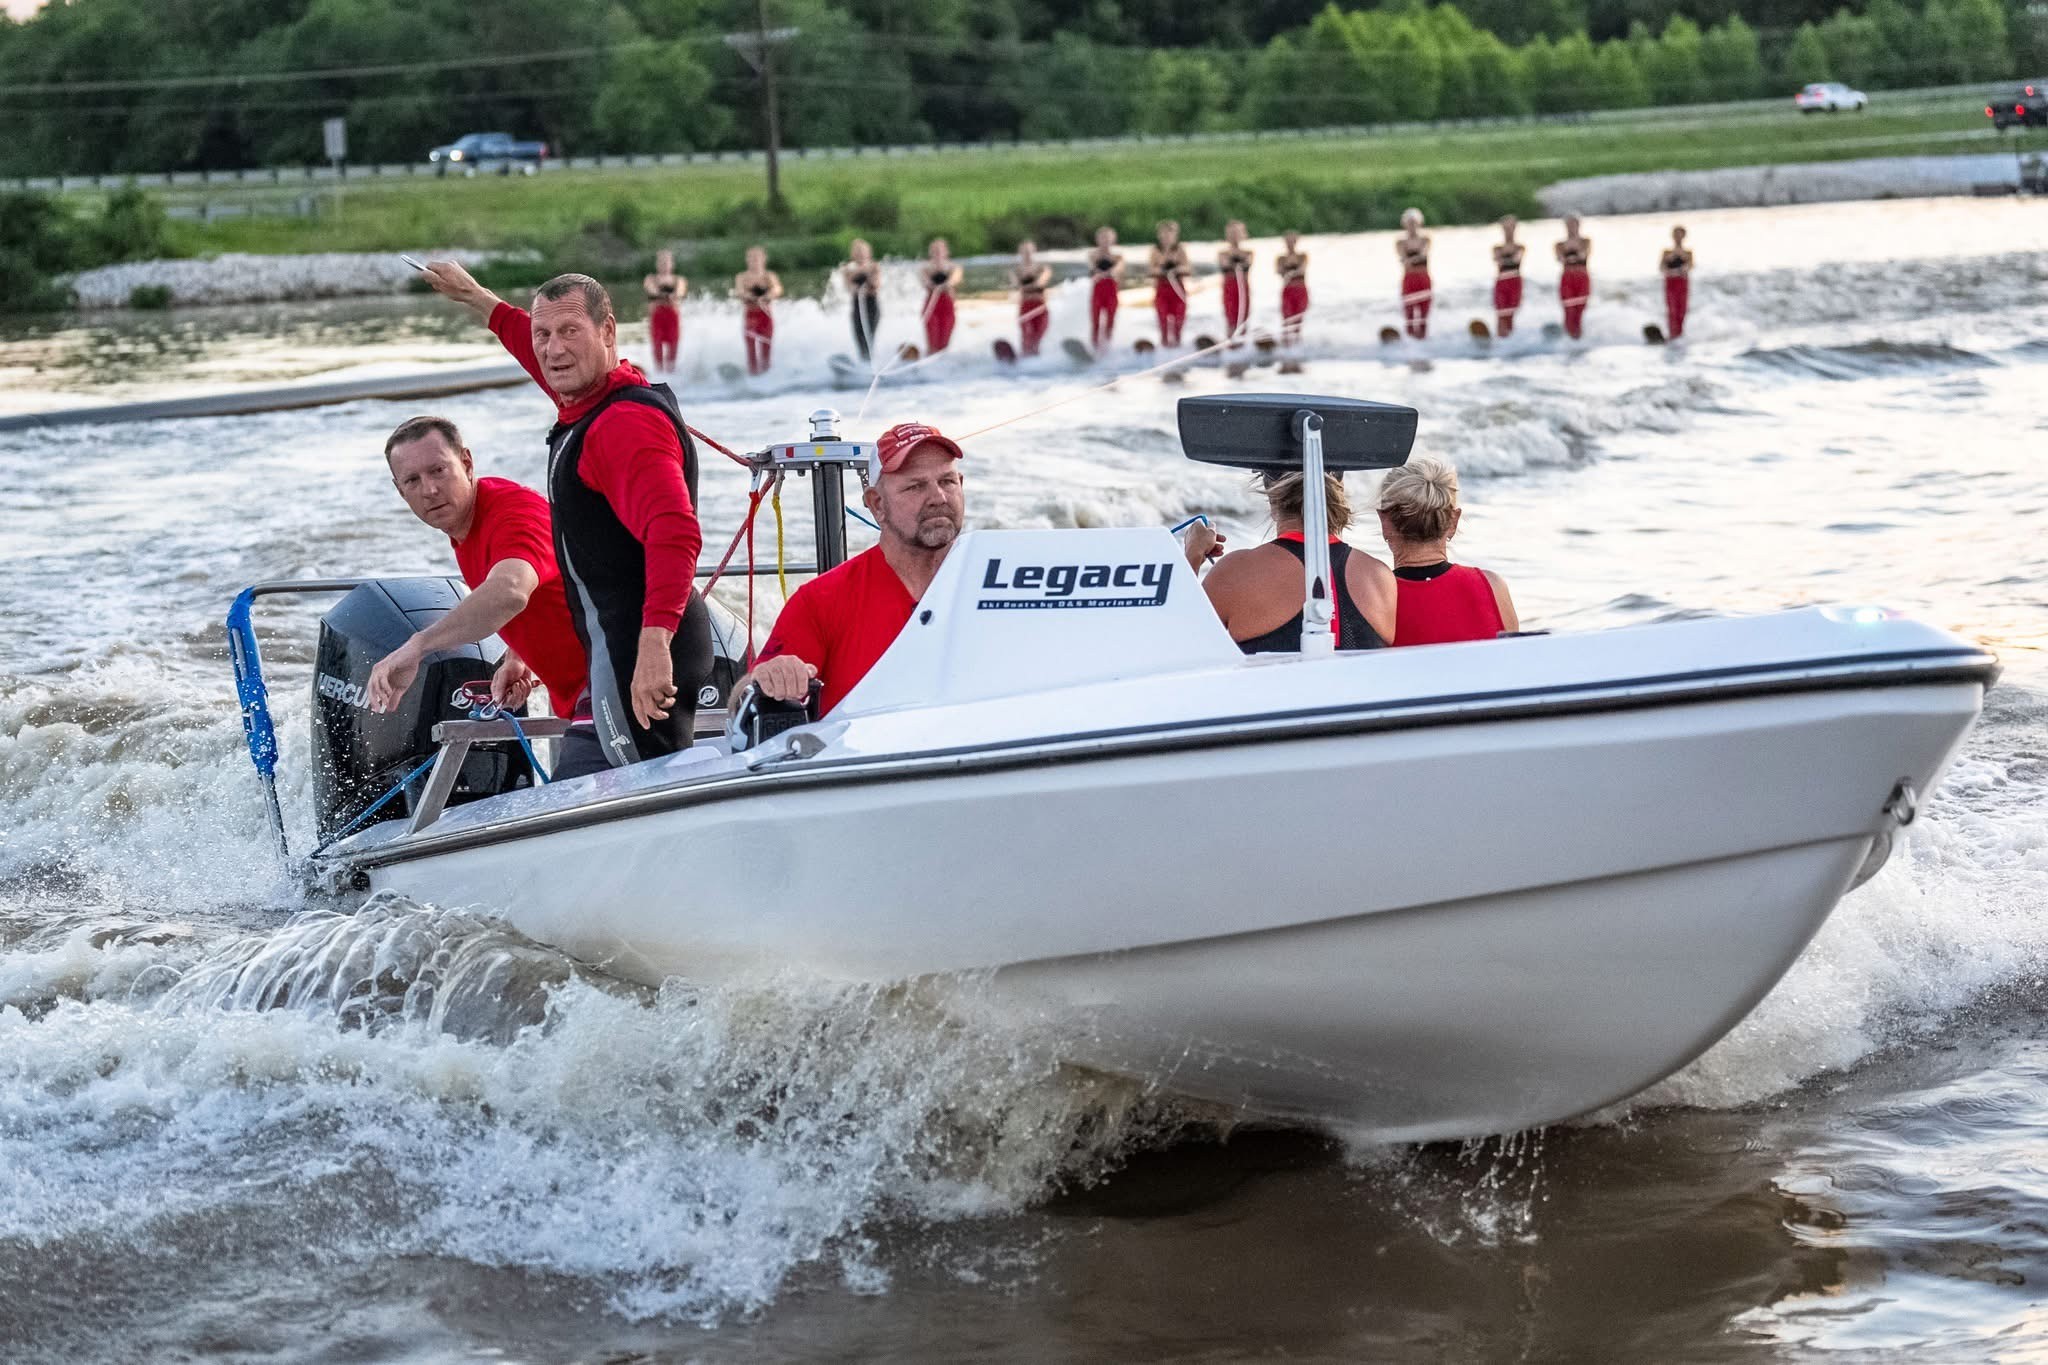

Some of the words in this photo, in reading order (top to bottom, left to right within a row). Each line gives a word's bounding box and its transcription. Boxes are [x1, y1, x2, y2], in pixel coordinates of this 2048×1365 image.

[982, 558, 1174, 603] Legacy
[981, 601, 1000, 609] Ski
[1003, 601, 1037, 609] Boats
[1040, 601, 1054, 609] by
[1087, 599, 1133, 608] Marine
[317, 671, 387, 714] MERCU
